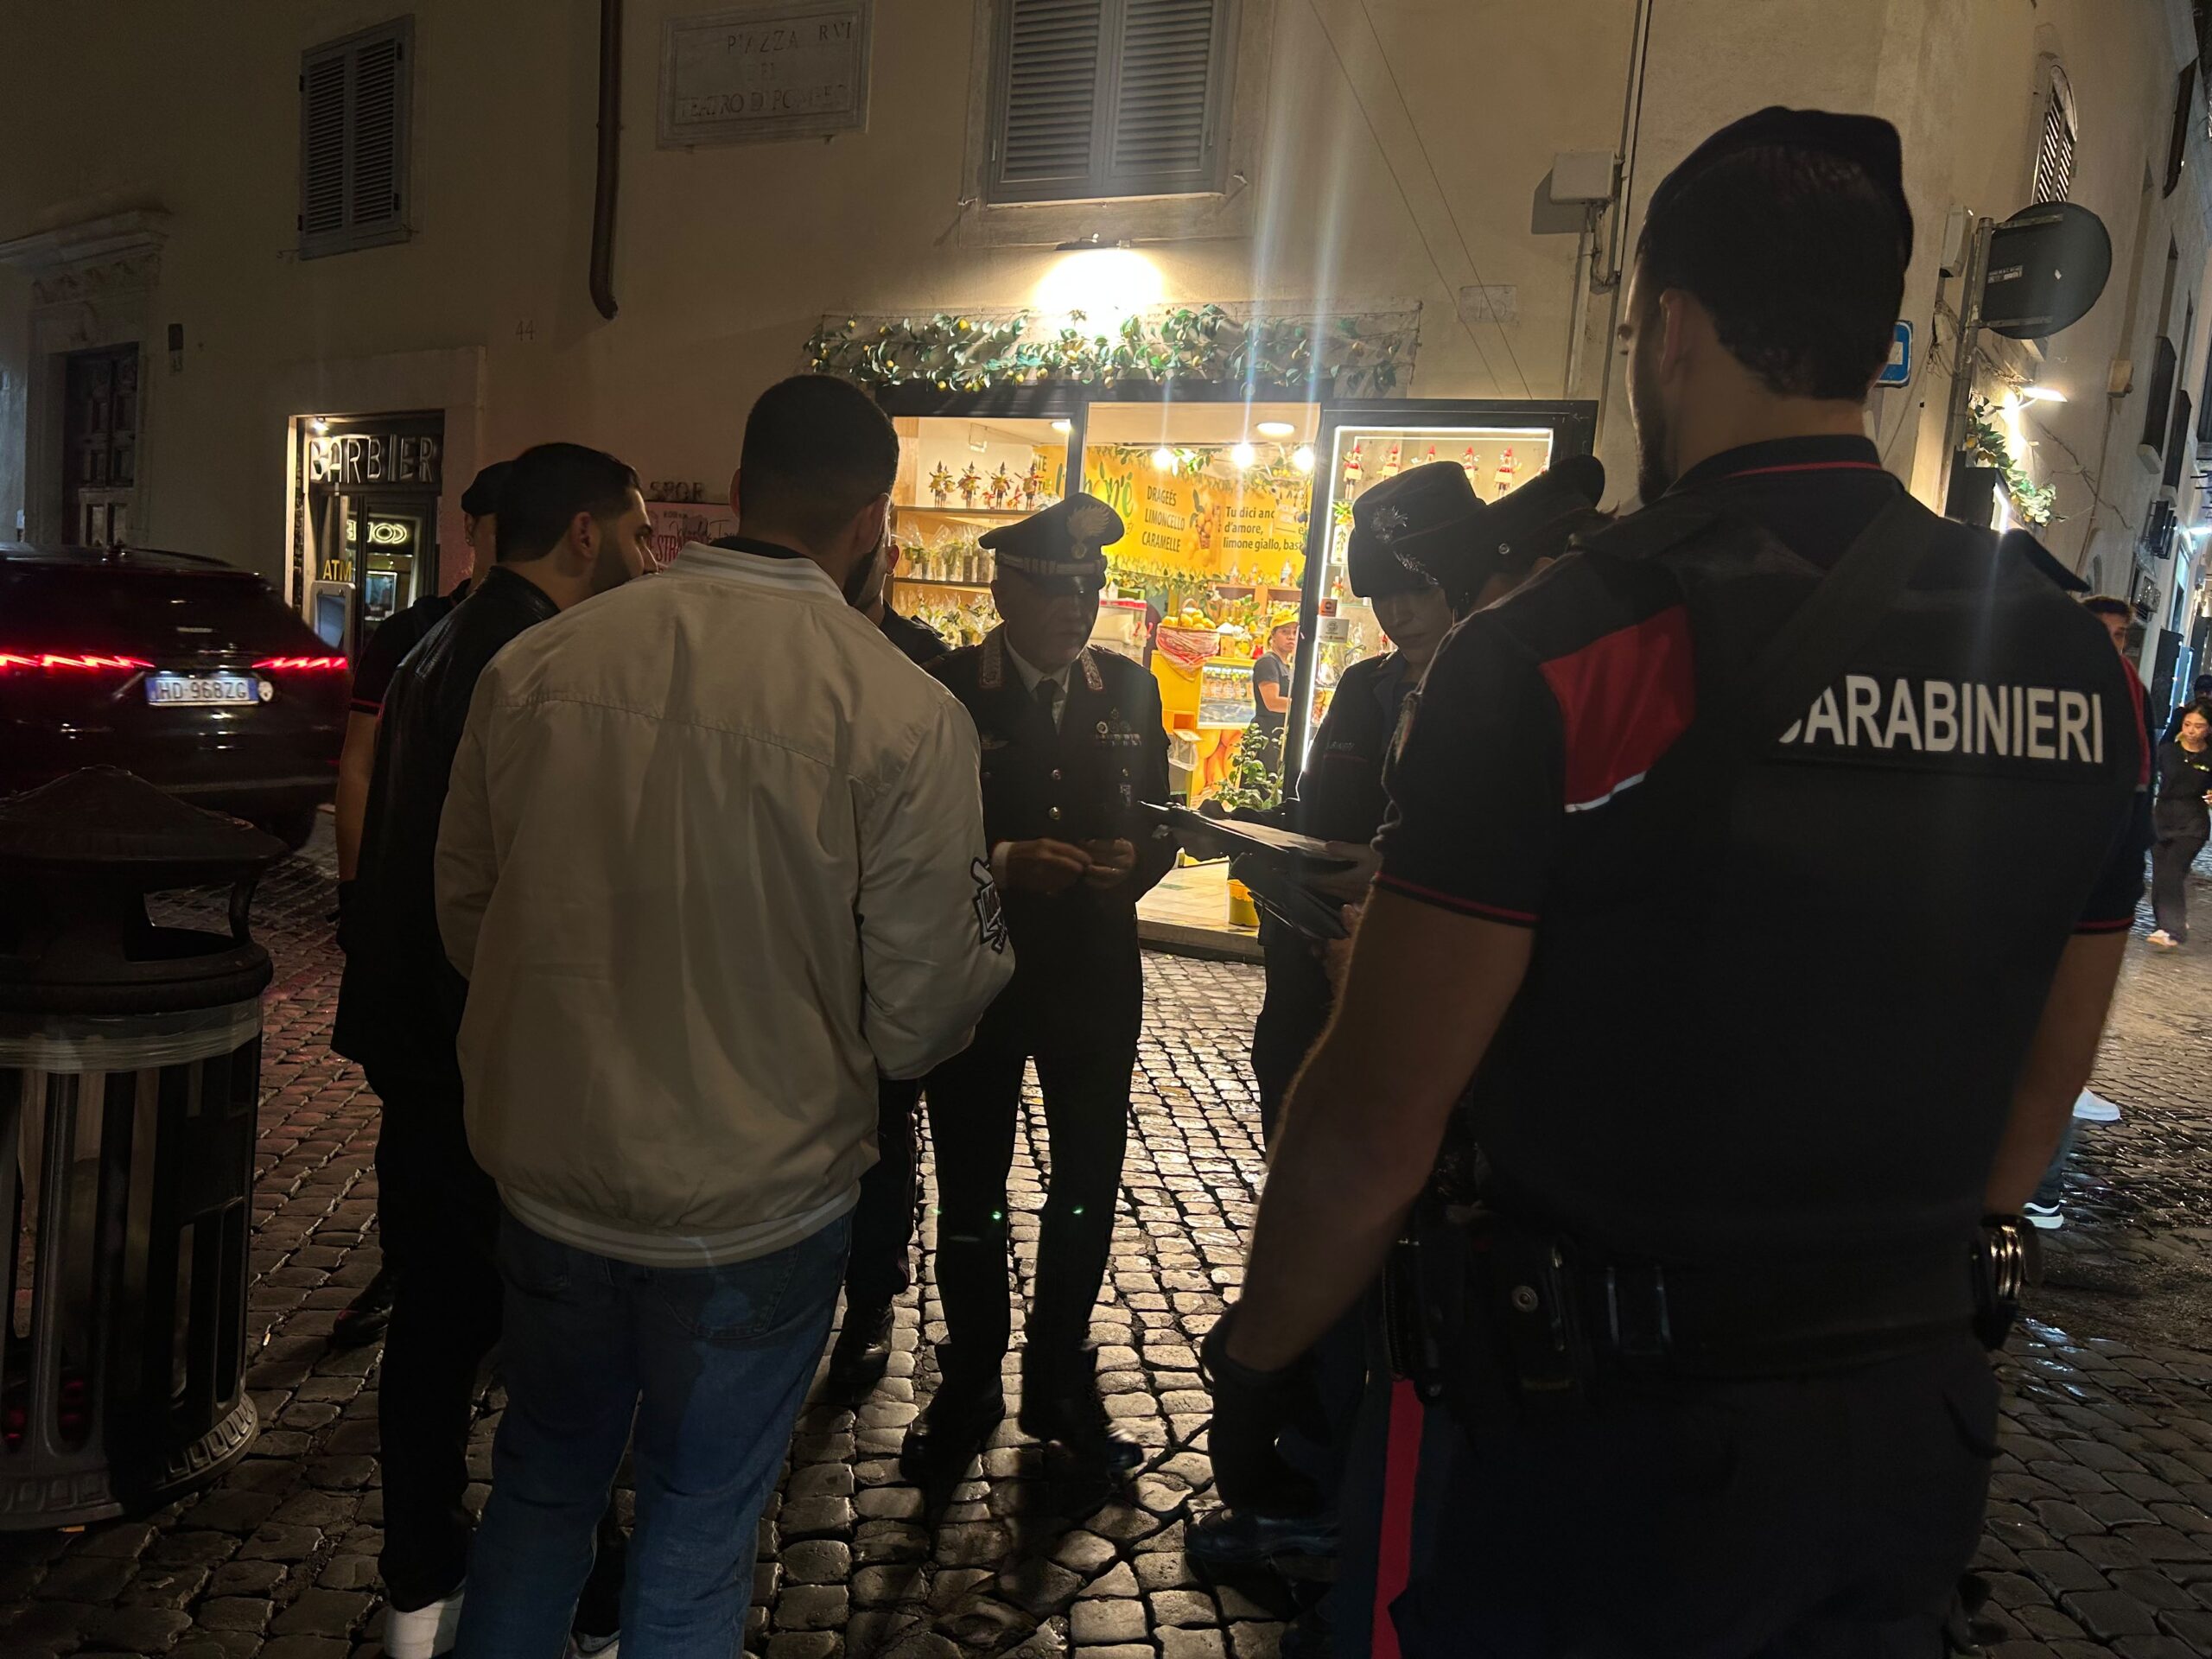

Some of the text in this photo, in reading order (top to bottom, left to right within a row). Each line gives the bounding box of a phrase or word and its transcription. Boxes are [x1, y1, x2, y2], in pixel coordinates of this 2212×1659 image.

[1144, 508, 1185, 531] LIMONCELLO
[1226, 505, 1275, 518] Tu dici anc
[1141, 531, 1181, 553] CARAMELLE
[1223, 537, 1253, 549] limone
[1255, 538, 1281, 552] giallo,
[322, 559, 353, 581] ATM
